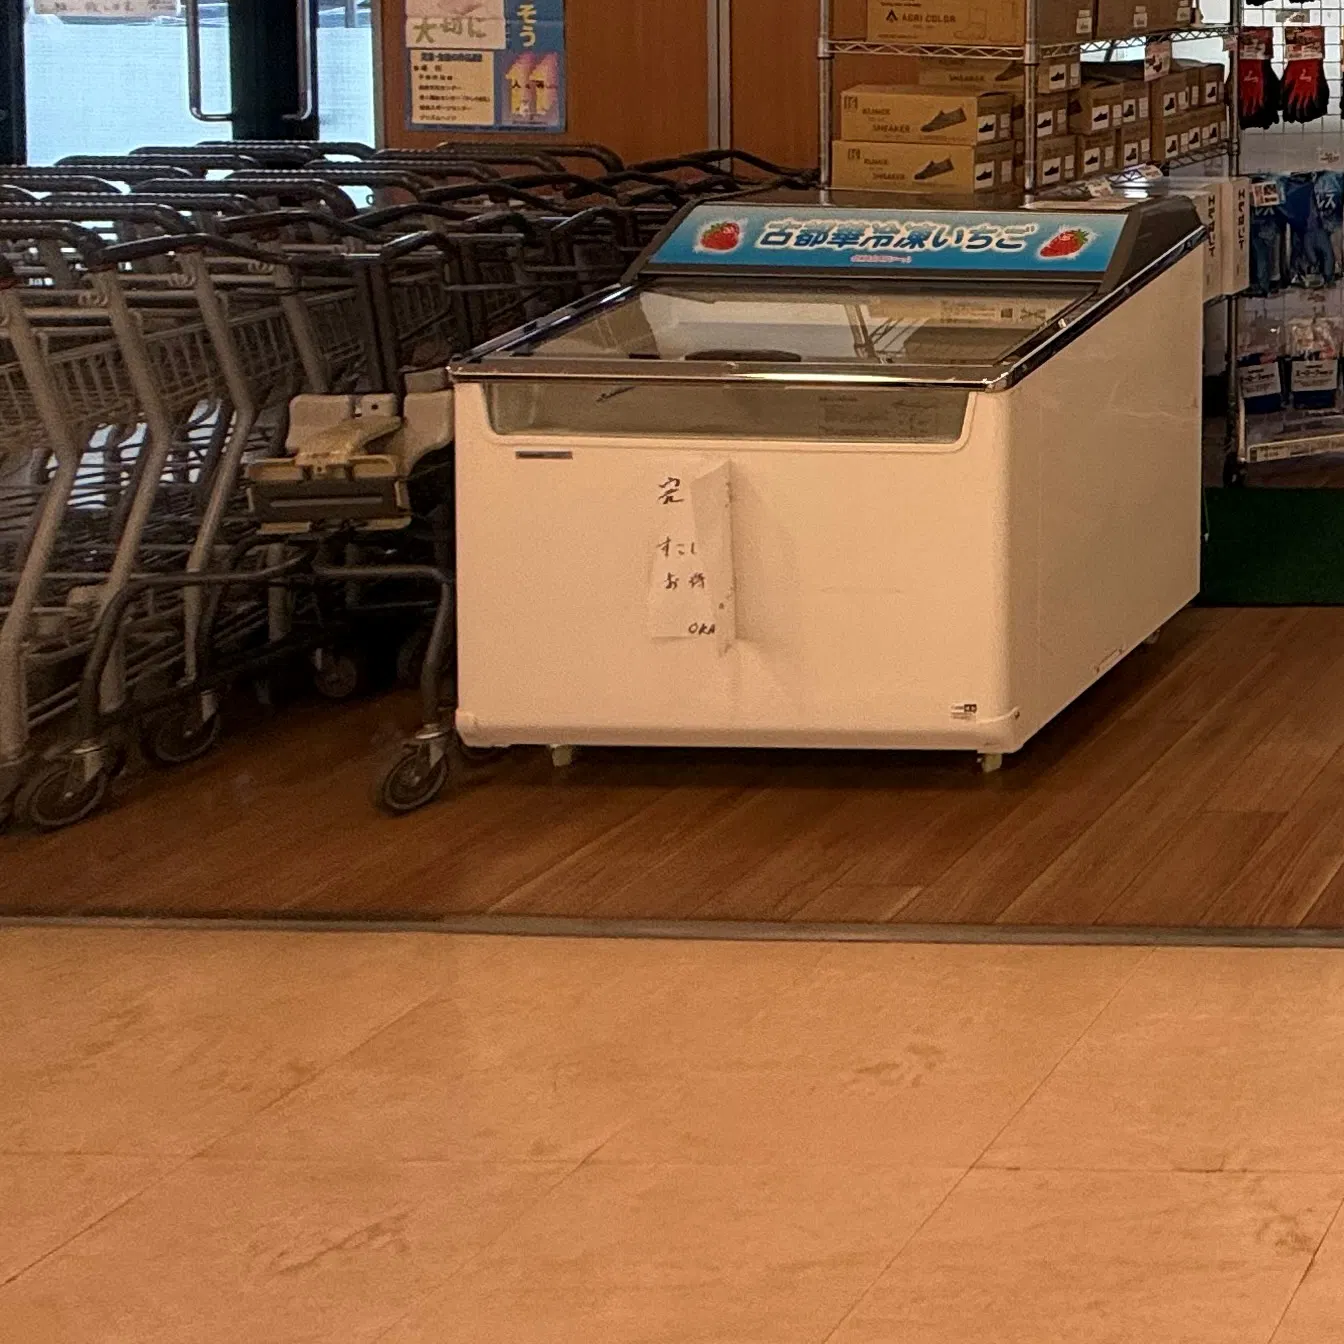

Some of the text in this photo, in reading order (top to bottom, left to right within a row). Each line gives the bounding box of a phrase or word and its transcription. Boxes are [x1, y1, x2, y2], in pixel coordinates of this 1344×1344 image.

[412, 17, 488, 44] 大切に
[759, 221, 1036, 250] 古都華冷凍いちご
